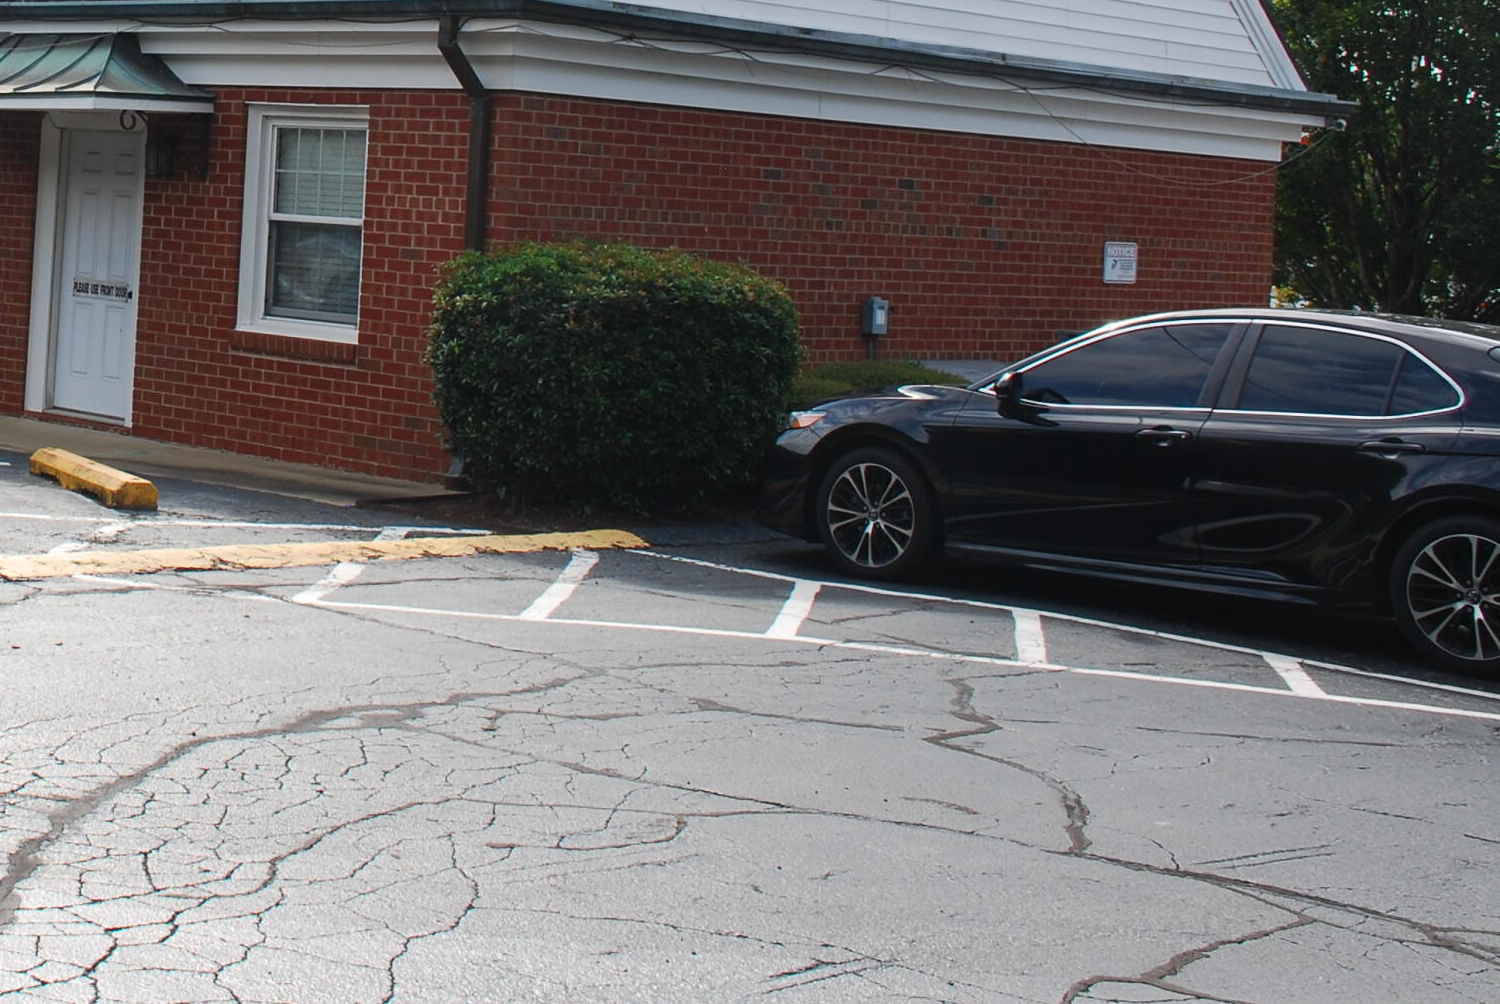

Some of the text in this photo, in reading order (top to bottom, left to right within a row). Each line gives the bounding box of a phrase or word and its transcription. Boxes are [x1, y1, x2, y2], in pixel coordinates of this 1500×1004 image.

[1107, 246, 1136, 257] NOTICE
[73, 281, 128, 298] PLEASE USE FRONT DOOR
